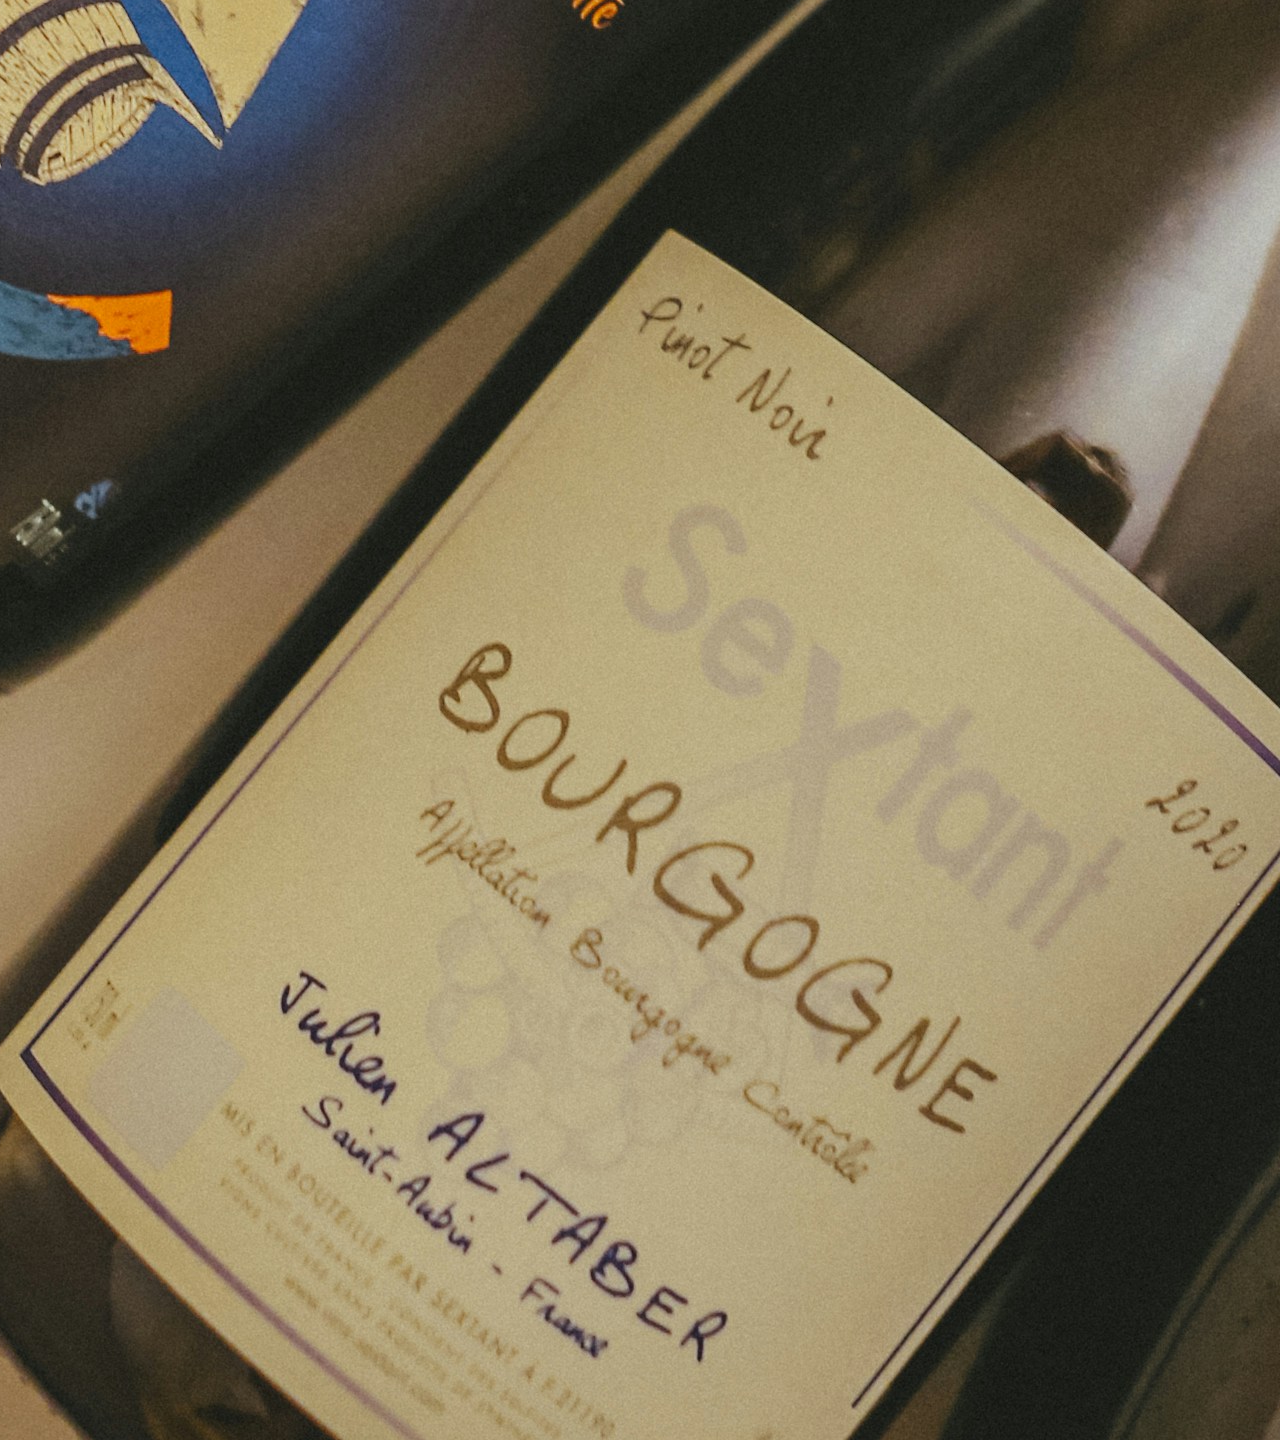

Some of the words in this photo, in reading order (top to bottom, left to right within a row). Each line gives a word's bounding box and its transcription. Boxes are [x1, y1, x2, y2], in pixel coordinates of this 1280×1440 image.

[638, 293, 752, 380] Pinot
[734, 365, 834, 460] Noir
[623, 505, 1128, 950] Sextant
[1142, 775, 1248, 872] 2020
[417, 799, 553, 929] Appellation
[566, 928, 729, 1079] Bourgogne
[437, 642, 1000, 1134] BOURGOGNE
[220, 1099, 256, 1140] MIS
[253, 1129, 287, 1168] EN
[283, 1157, 388, 1259] BOUTEILLE
[384, 1250, 431, 1295] PAR
[425, 1285, 521, 1372] SEXTANT
[280, 970, 394, 1107] Julien
[424, 1112, 728, 1362] ALTABER
[300, 1097, 474, 1256] Saint-Aubin
[518, 1276, 610, 1358] France
